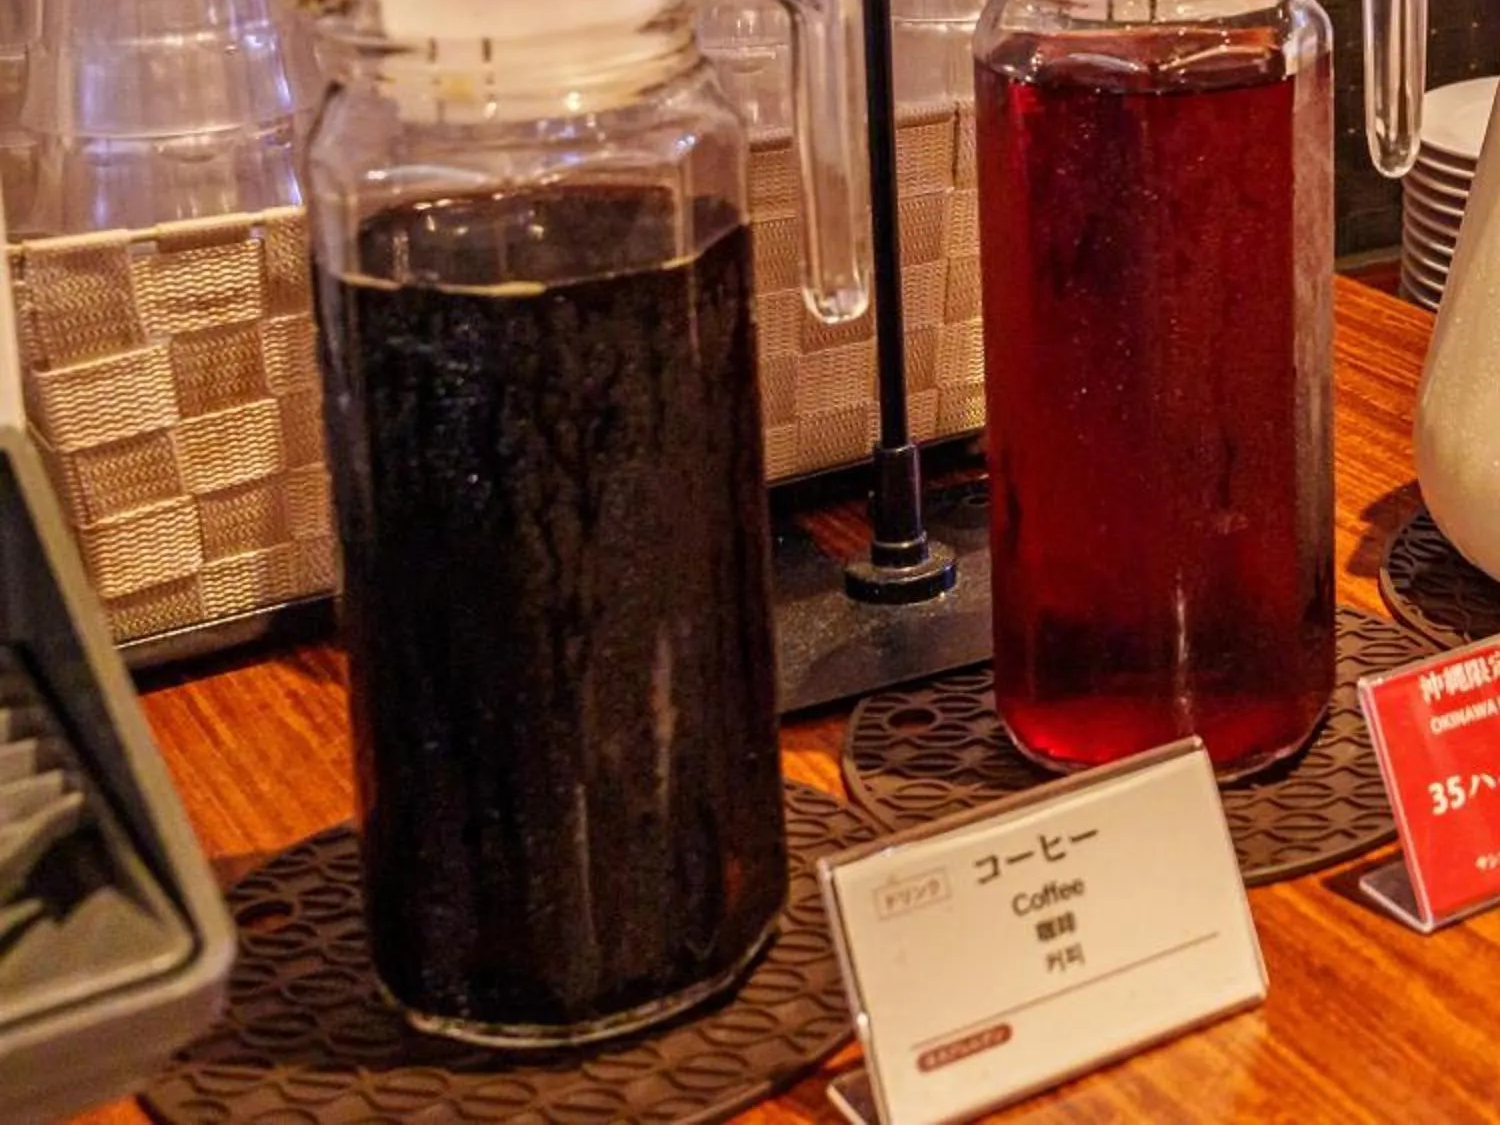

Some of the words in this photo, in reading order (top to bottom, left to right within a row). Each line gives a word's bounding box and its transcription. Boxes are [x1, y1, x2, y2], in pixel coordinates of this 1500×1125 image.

[1430, 699, 1498, 734] OKINAWA
[972, 828, 1099, 886] コーヒー
[1011, 878, 1086, 918] Coffee
